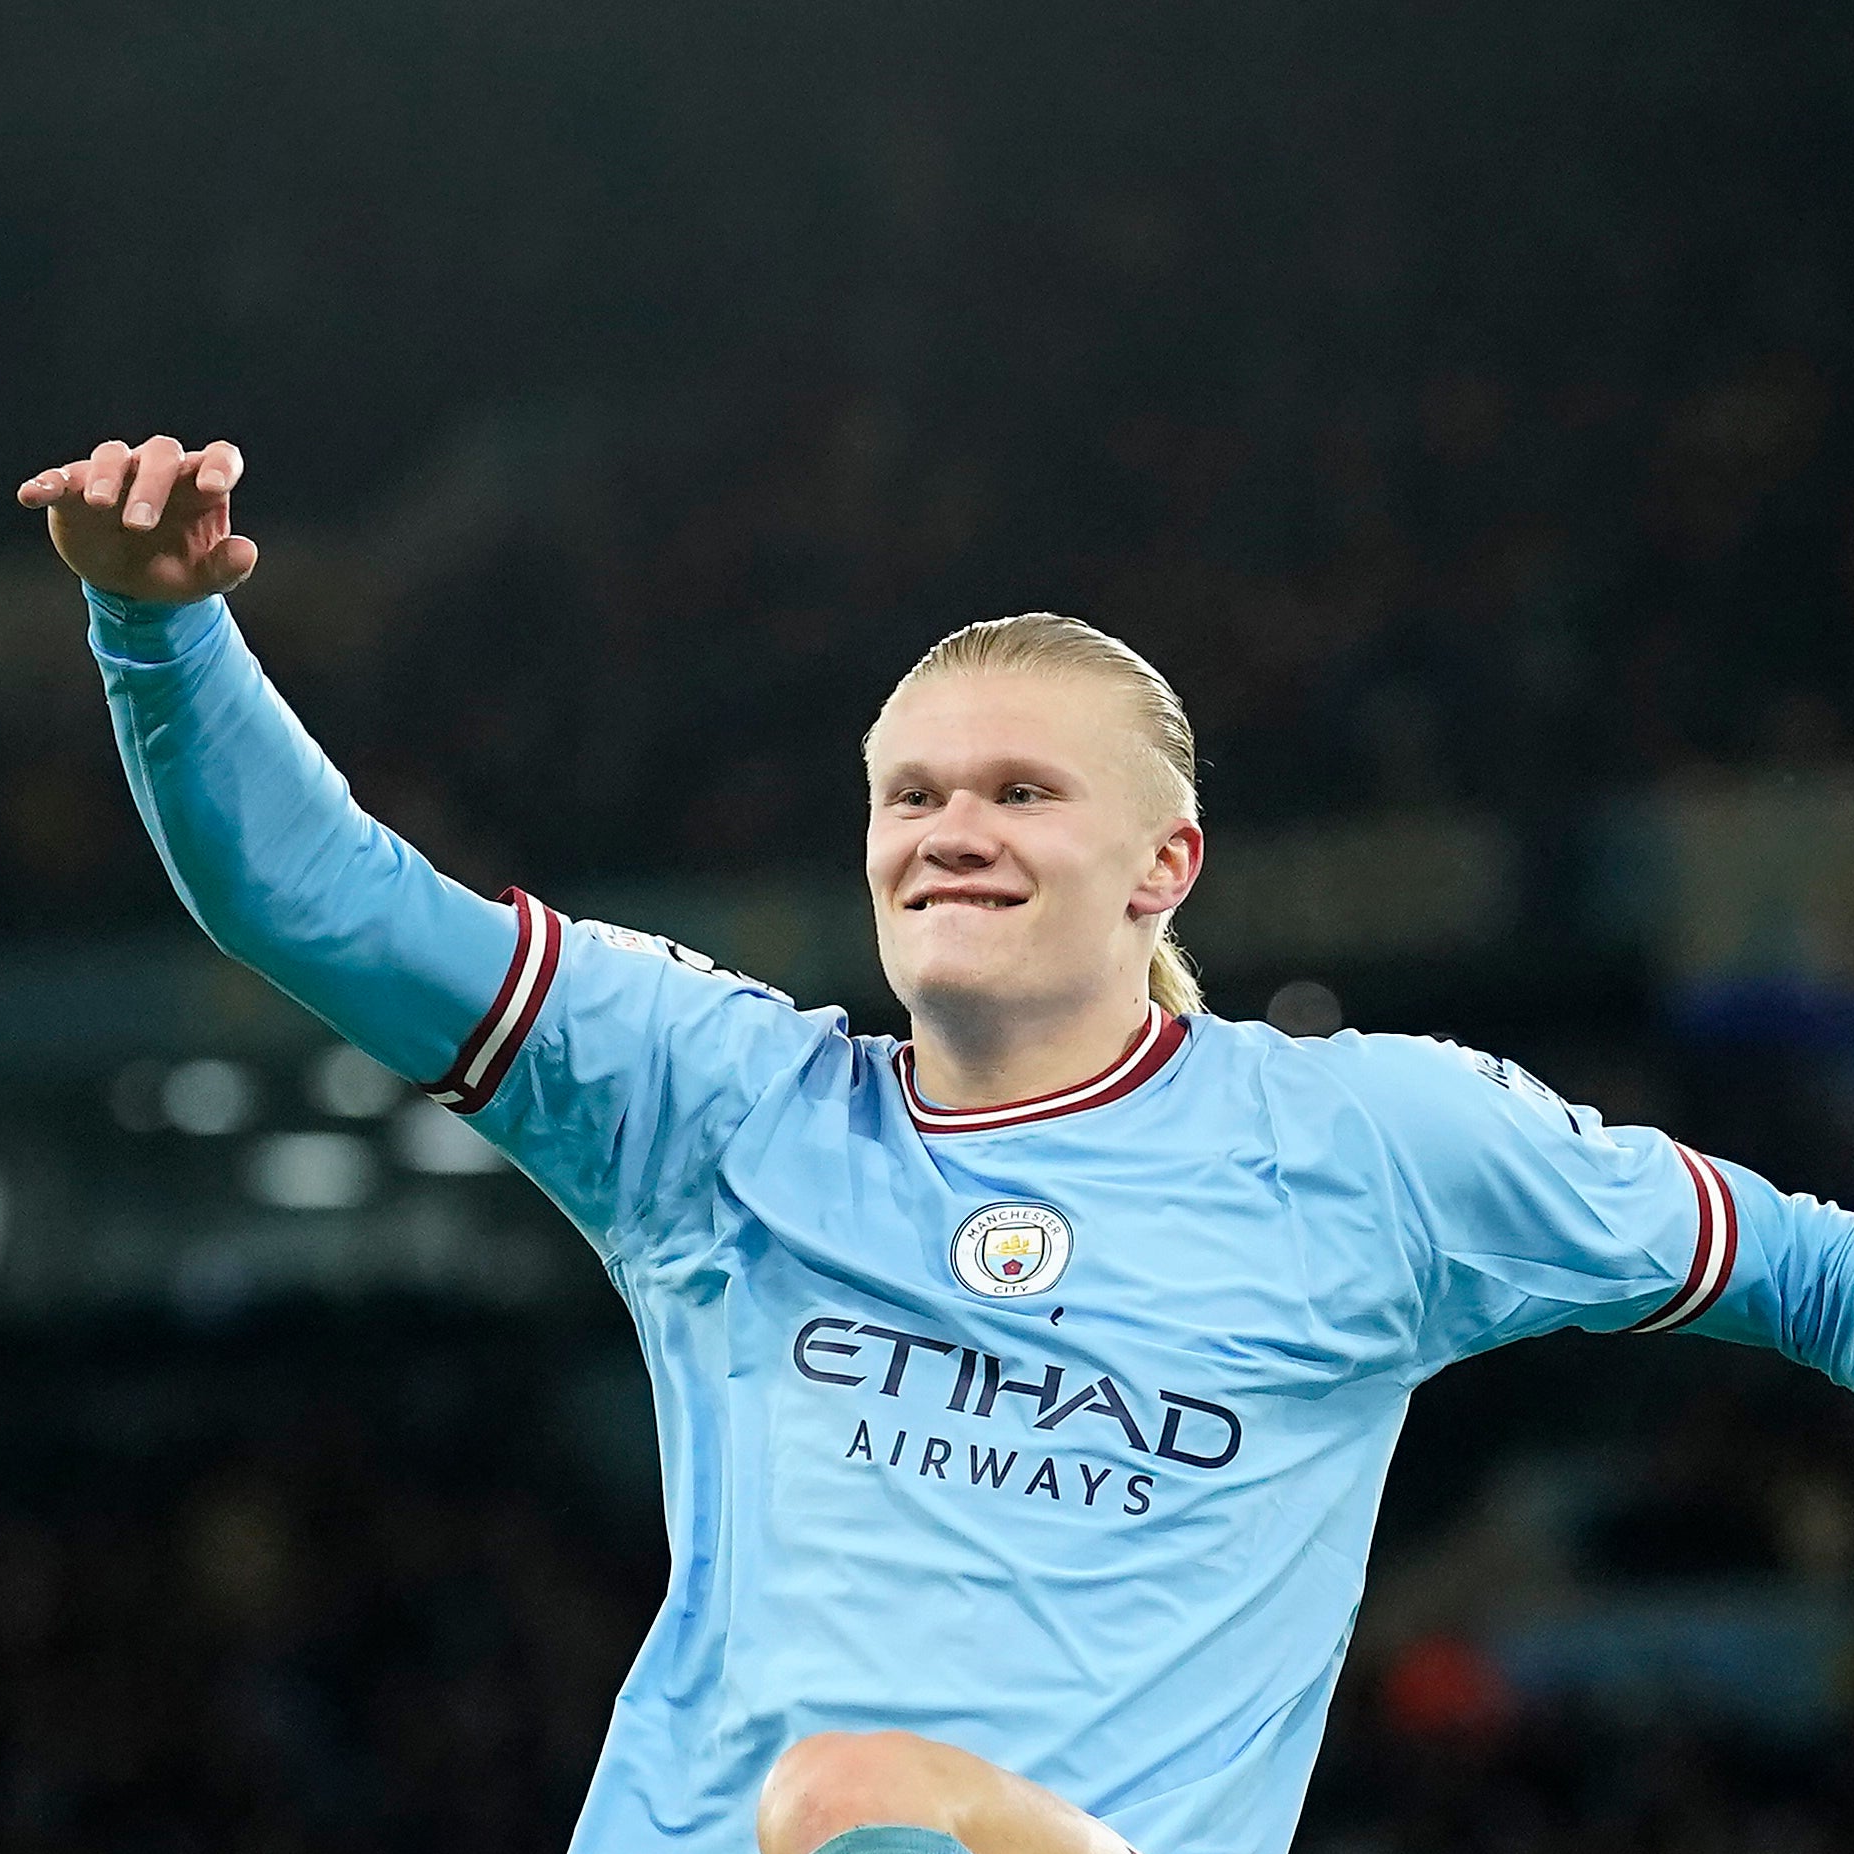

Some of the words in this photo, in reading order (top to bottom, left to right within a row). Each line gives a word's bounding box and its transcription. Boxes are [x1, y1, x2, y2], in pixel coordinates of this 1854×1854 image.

[967, 1210, 1062, 1240] MANCHESTER
[993, 1285, 1029, 1294] CITY
[793, 1316, 1243, 1470] ETIHAD
[845, 1419, 1156, 1516] AIRWAYS
